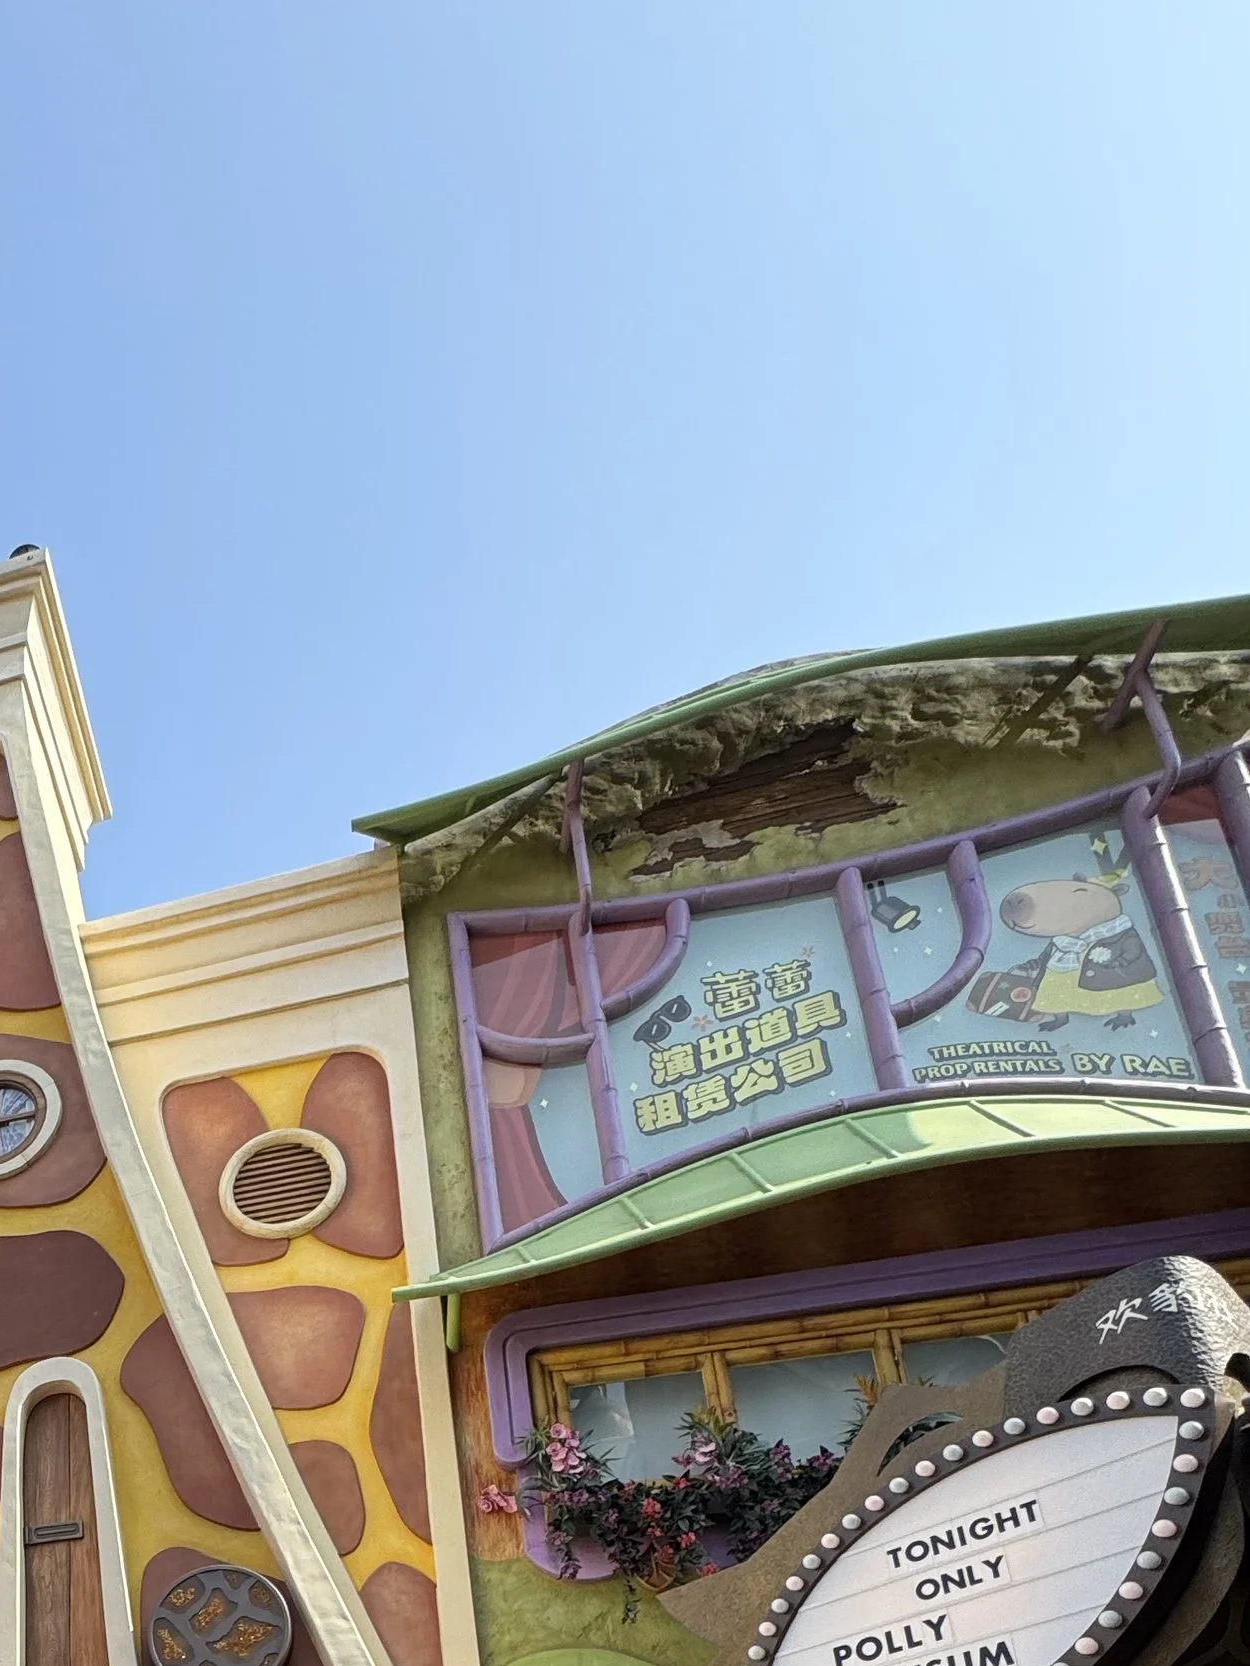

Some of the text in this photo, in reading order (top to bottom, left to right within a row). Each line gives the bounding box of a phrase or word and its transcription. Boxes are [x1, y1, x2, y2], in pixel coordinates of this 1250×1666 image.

[701, 958, 812, 1022] 蕾蕾
[650, 989, 848, 1088] 演出道具
[929, 1040, 1058, 1062] THEATRICAL
[1072, 1052, 1195, 1078] BY RAE
[634, 1037, 833, 1136] 租赁公司
[913, 1057, 1063, 1083] PROP RENTALS
[886, 1500, 1037, 1568] TONIGHT
[915, 1555, 1004, 1600] ONLY
